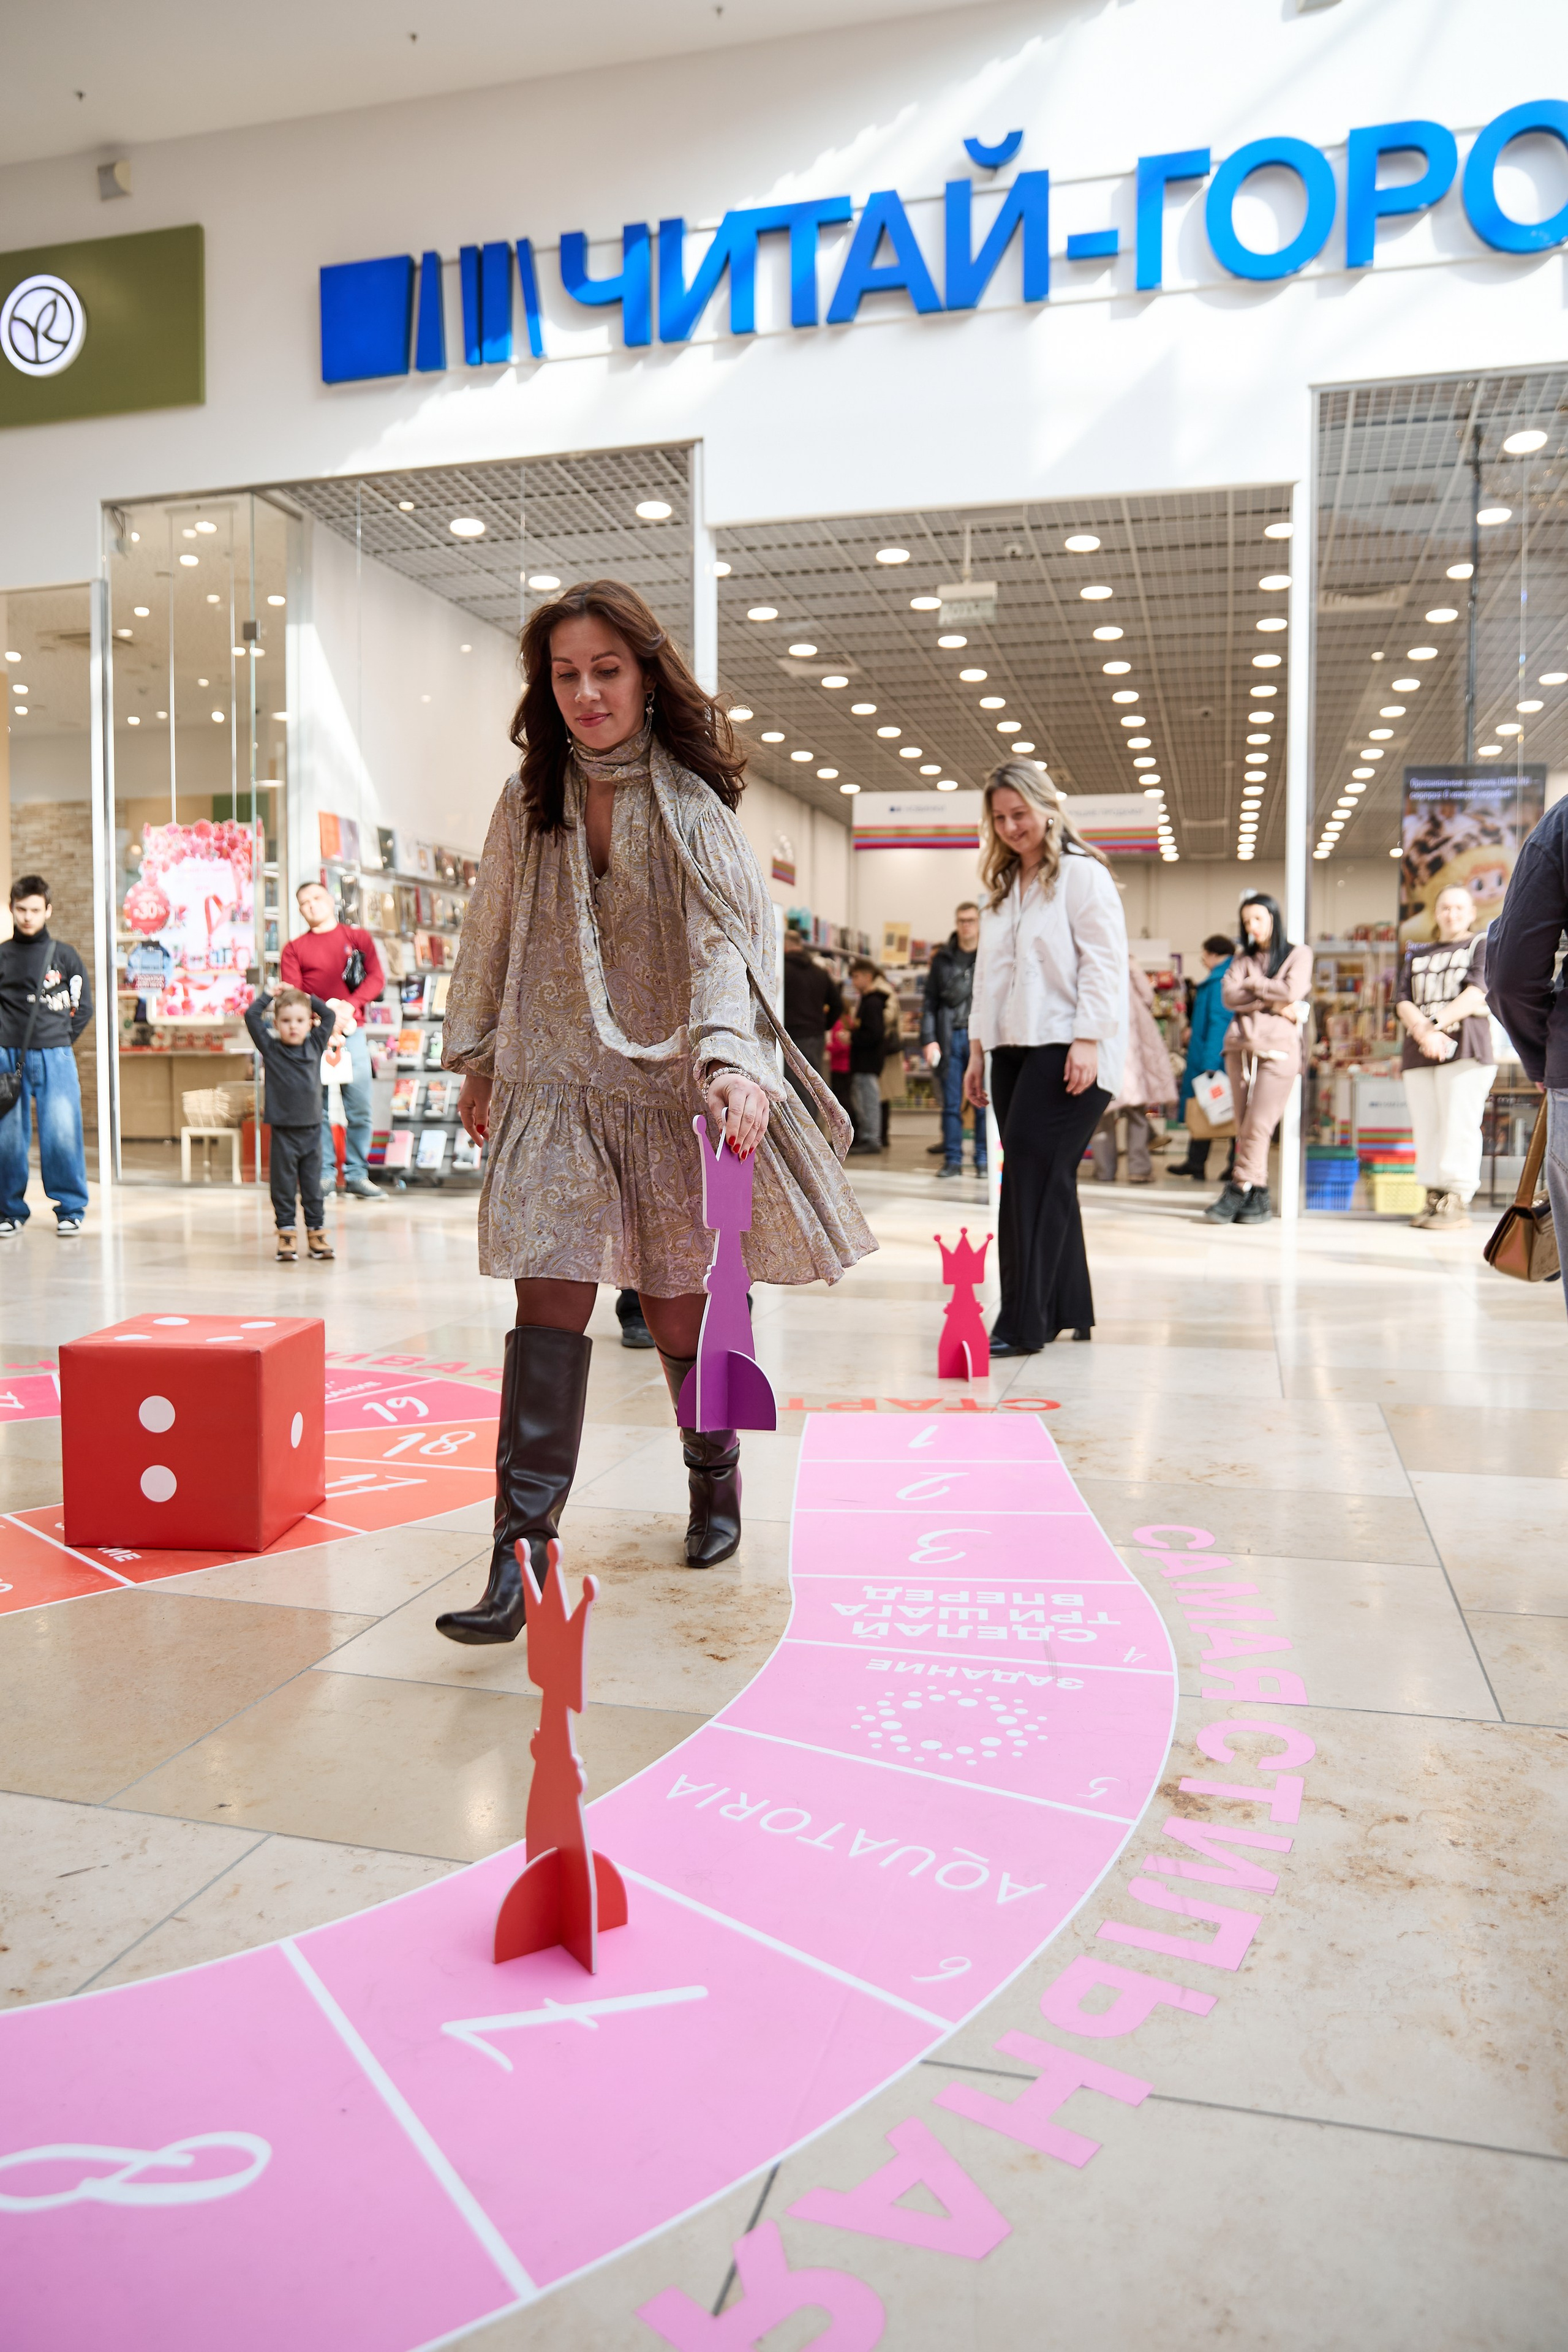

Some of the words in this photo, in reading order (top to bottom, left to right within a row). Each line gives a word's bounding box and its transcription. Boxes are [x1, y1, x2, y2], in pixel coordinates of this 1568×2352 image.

[361, 1395, 429, 1423] 19
[777, 1397, 1061, 1412] СТАРТ
[382, 1430, 477, 1458] 18
[907, 1425, 938, 1449] 1
[895, 1472, 969, 1501] 2
[908, 1528, 992, 1564] 3
[861, 1585, 1085, 1607] ВПЕРЕД
[830, 1602, 989, 1621] ШАГА
[1009, 1608, 1121, 1625] ТРИ
[1133, 1523, 1310, 1706] САМАЯ
[851, 1620, 1098, 1643] СДЕЛАЙ
[1122, 1645, 1148, 1664] 4
[865, 1658, 1085, 1690] ЗАДАНИЕ
[1076, 1776, 1121, 1799] 5
[666, 1773, 1049, 1905] AQUATORIA
[910, 1955, 973, 1983] 6
[440, 1985, 709, 2071] 7
[0, 2130, 273, 2213] 8
